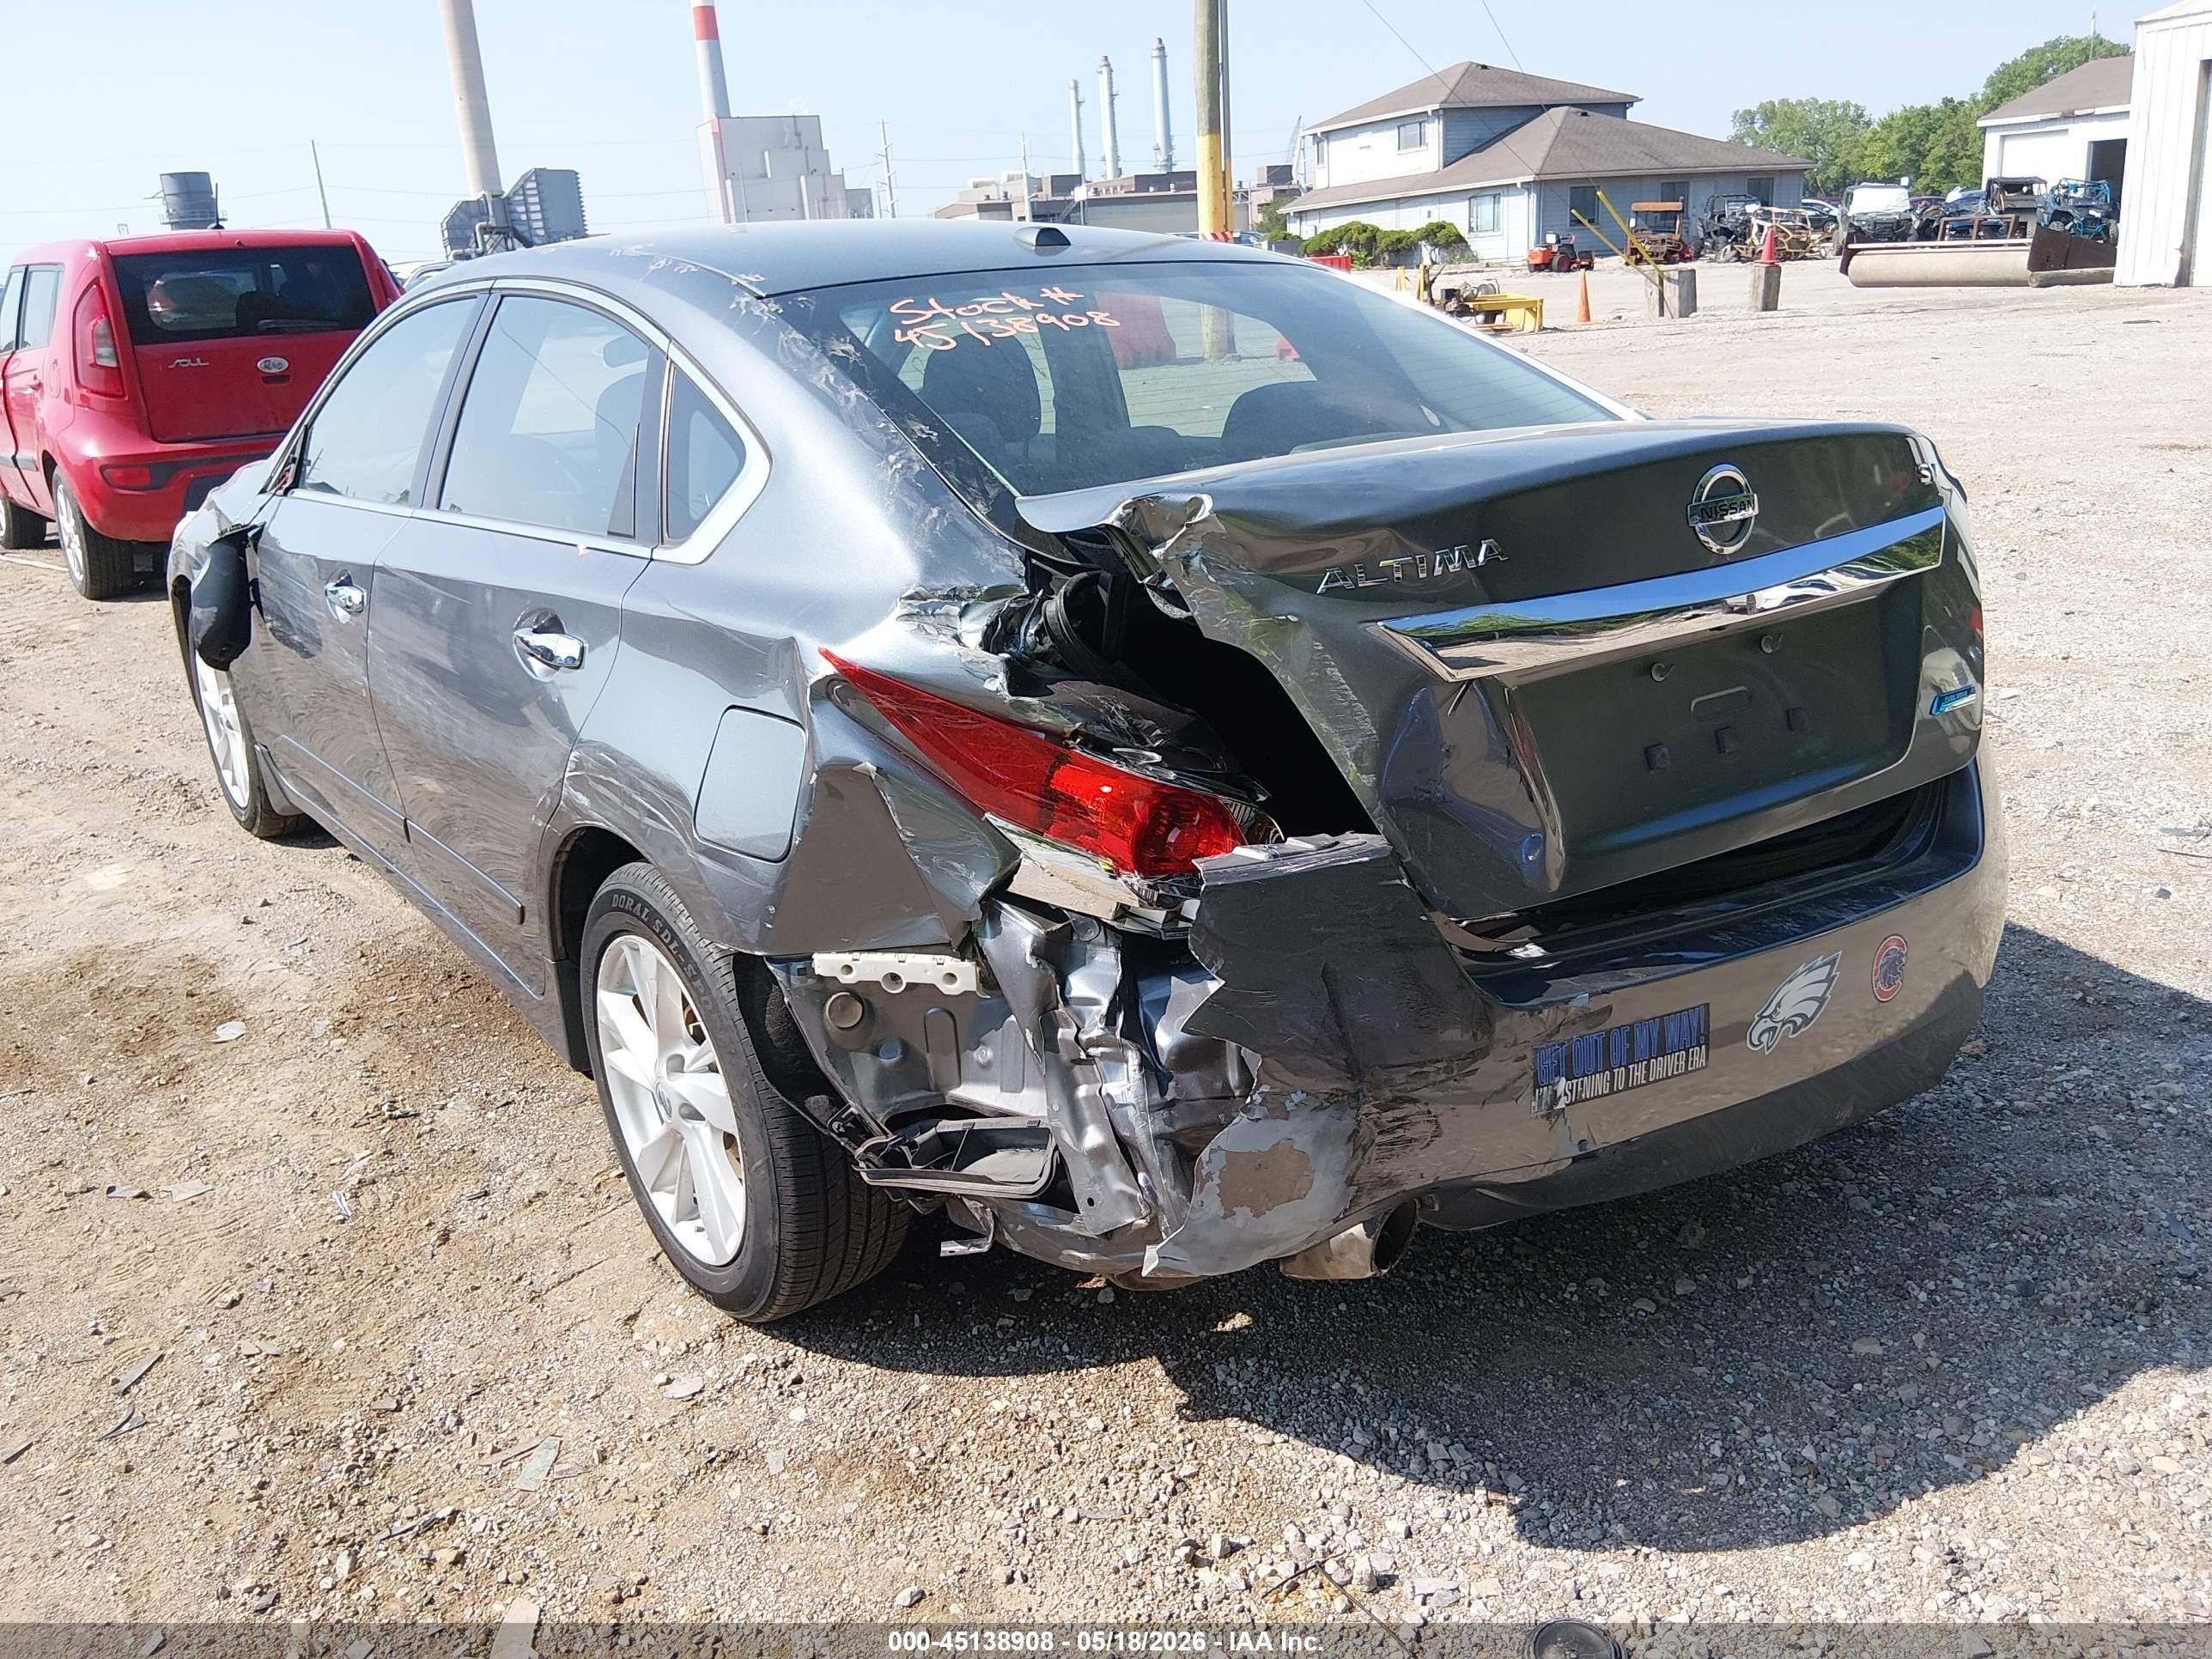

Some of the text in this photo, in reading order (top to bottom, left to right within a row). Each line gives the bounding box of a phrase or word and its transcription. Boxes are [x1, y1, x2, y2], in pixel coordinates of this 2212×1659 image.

[890, 287, 1085, 325] Stock #
[894, 310, 1121, 350] 45138908
[1701, 500, 1755, 522] NISSAN
[1316, 538, 1510, 594] ALTIMA
[612, 894, 653, 921] DORAL
[1537, 1006, 1705, 1086] GET OUT OF MY WAY!
[1556, 1075, 1610, 1107] STENING
[1613, 1066, 1626, 1091] TO
[1628, 1060, 1647, 1088] THE
[1649, 1051, 1686, 1082] DRIVER
[1688, 1044, 1706, 1070] ERA
